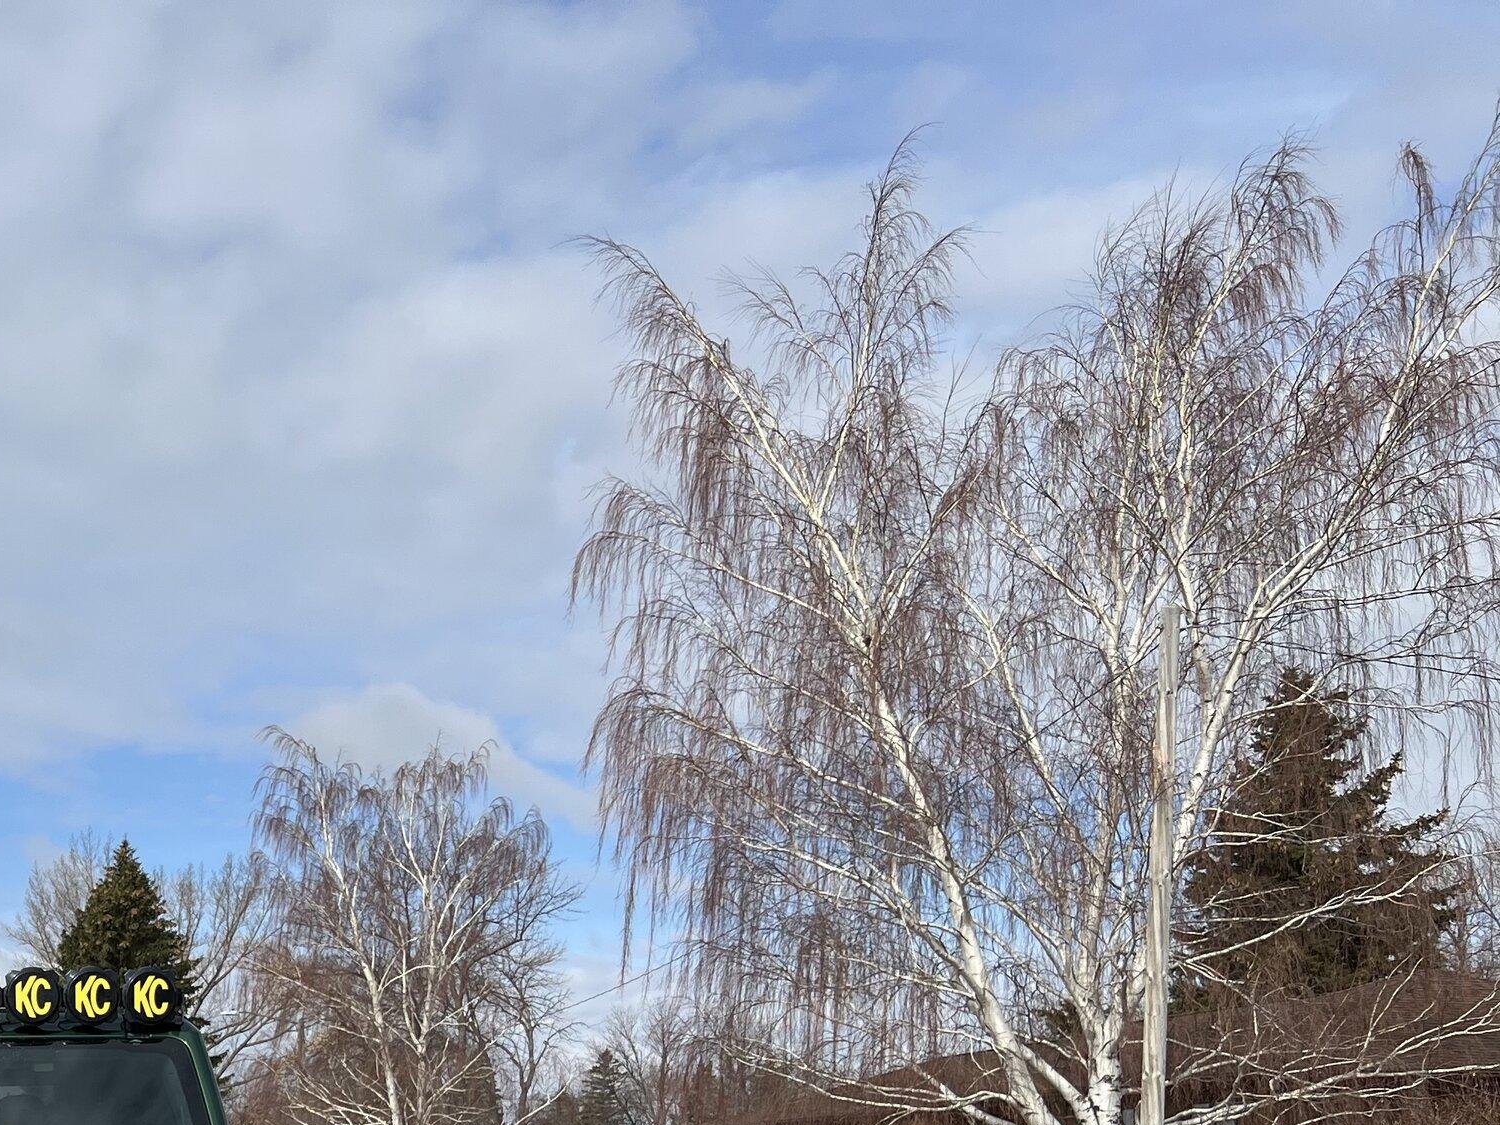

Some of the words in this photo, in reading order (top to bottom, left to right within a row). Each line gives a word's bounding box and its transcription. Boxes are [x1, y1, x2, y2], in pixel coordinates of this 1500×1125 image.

[16, 977, 52, 1017] KC
[76, 976, 111, 1017] KC
[134, 976, 169, 1016] KC
